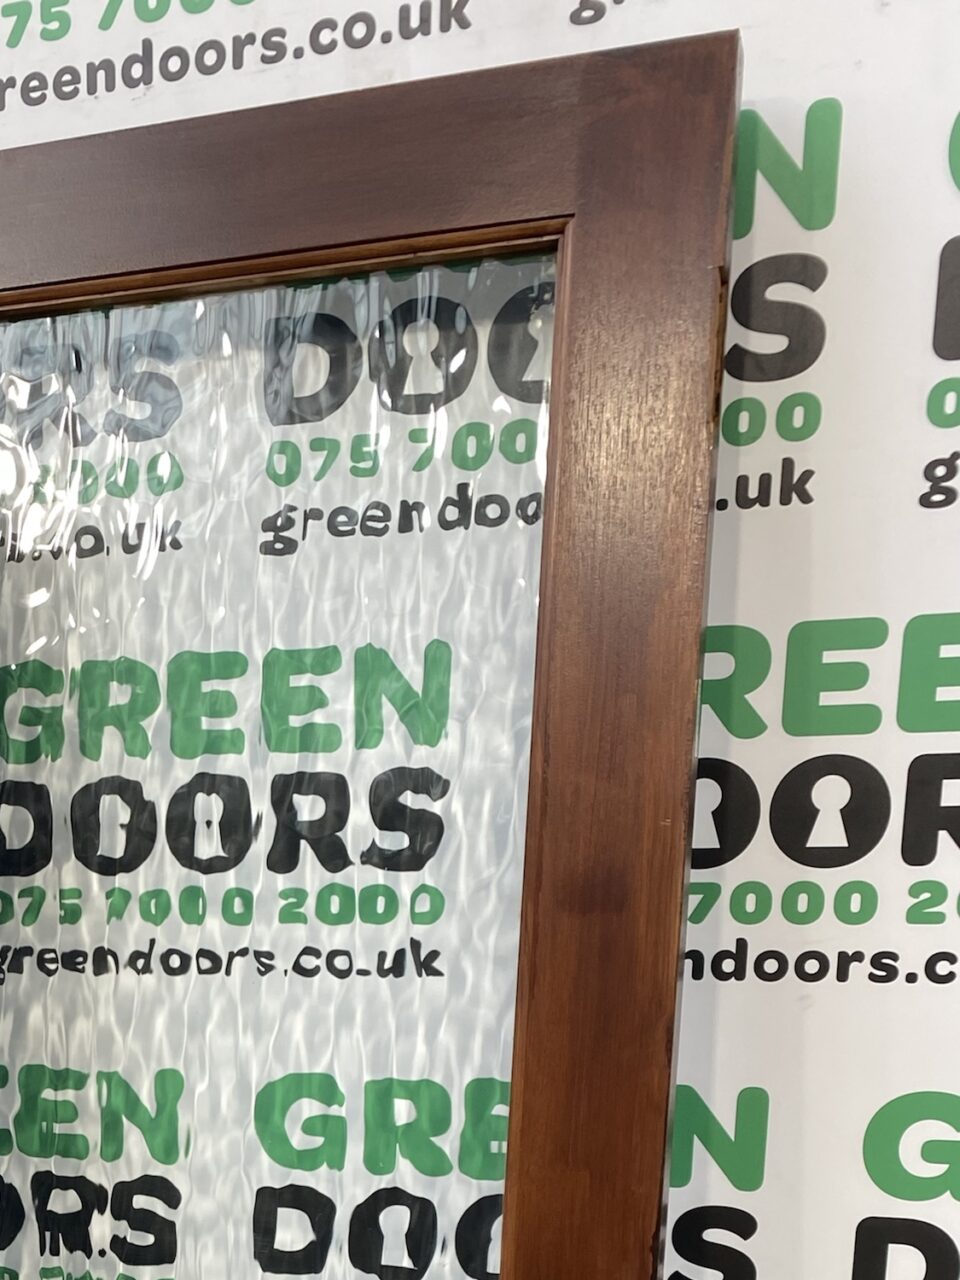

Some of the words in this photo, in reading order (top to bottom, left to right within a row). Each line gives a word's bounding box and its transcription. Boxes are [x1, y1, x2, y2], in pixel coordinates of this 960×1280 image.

[266, 433, 381, 487] 075
[104, 885, 255, 927] 7000
[277, 882, 446, 926] 2000
[687, 880, 879, 926] 7000
